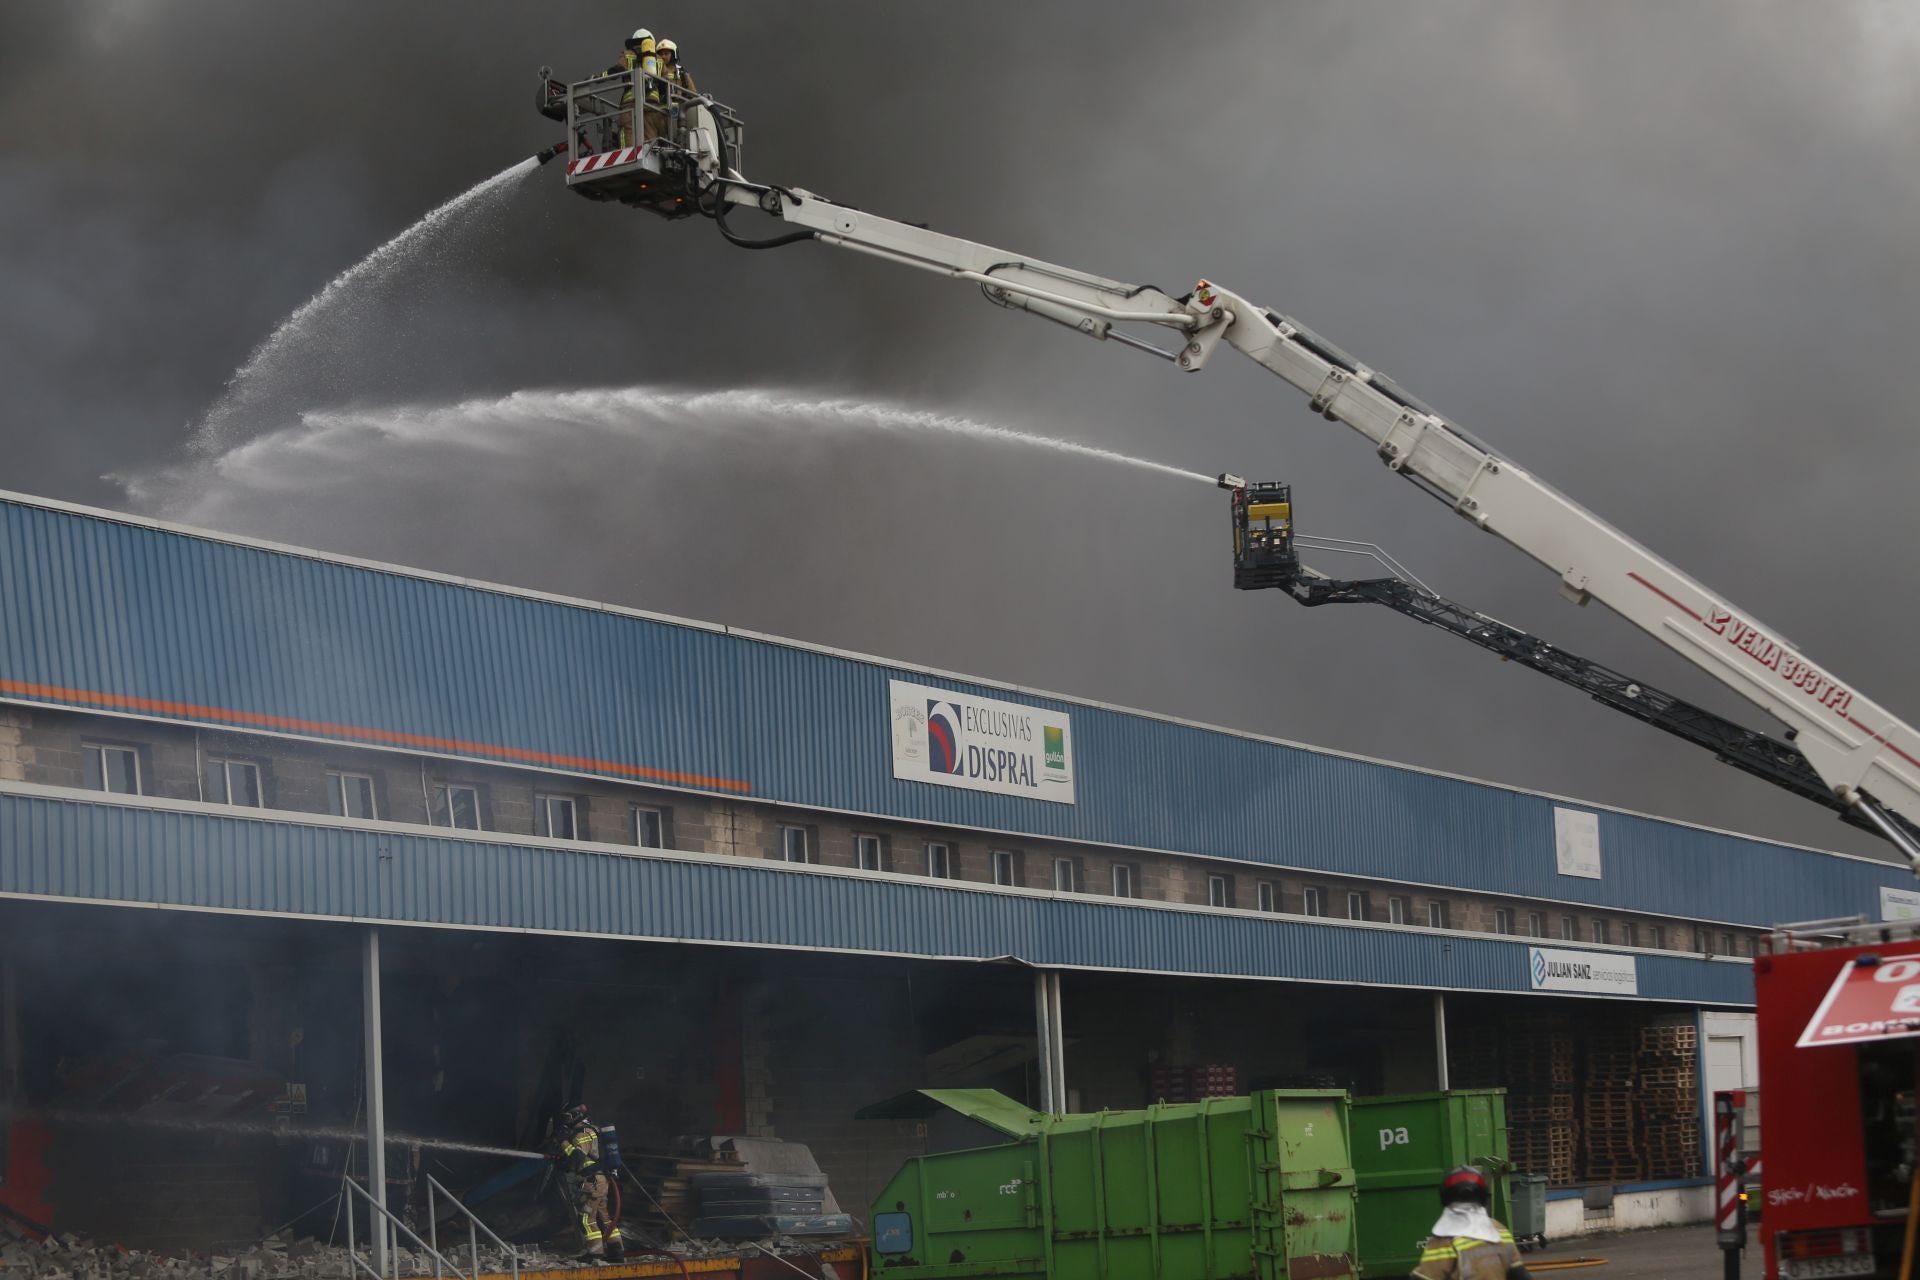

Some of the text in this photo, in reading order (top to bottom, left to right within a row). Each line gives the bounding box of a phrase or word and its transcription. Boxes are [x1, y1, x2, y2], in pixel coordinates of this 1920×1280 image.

[966, 705, 1032, 742] EXCLUSIVAS
[968, 744, 1038, 788] DISPRAL
[1546, 961, 1572, 979] JULIAN
[1573, 963, 1592, 980] SANZ
[1378, 1126, 1410, 1152] pa
